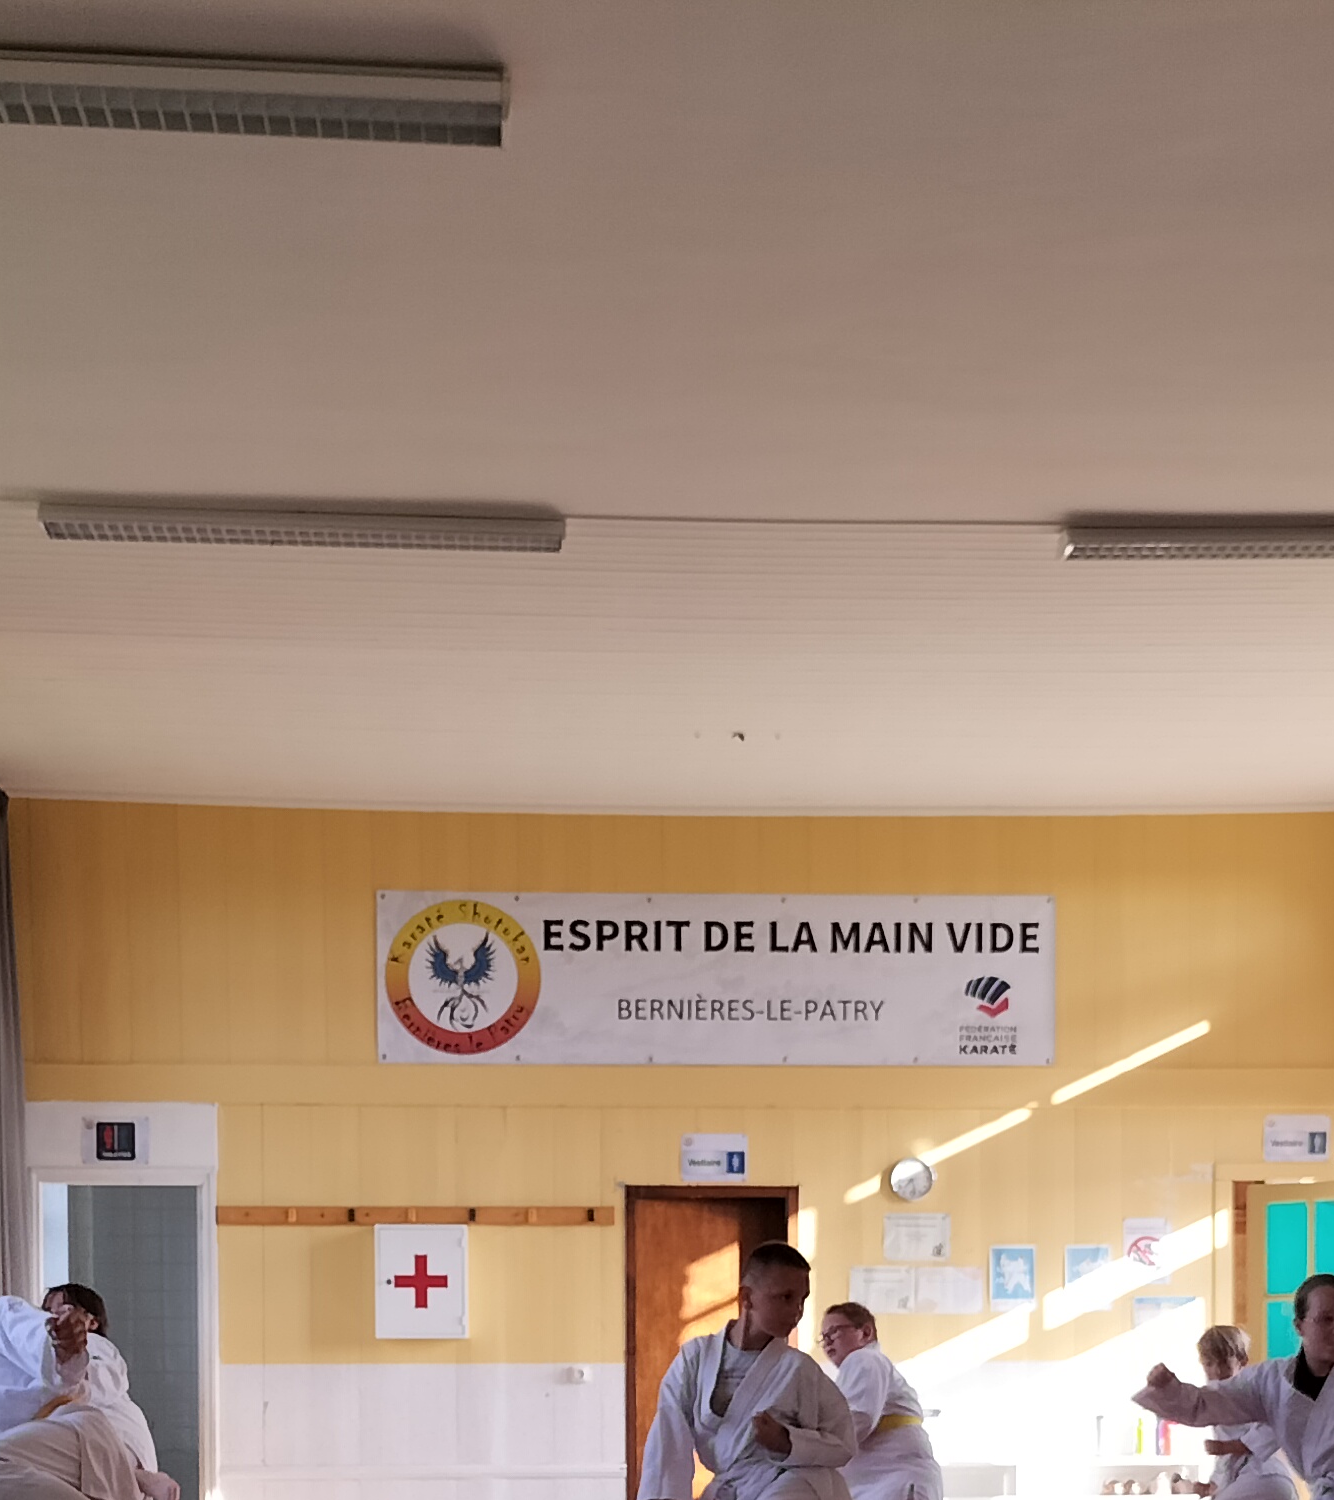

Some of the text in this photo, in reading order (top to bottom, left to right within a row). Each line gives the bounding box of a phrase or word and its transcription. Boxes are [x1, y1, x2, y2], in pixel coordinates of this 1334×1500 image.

[543, 919, 1040, 954] ESPRIT DE LA MAIN VIDE
[617, 993, 885, 1022] BERNIÈRES-LE-PATRY
[959, 1043, 1017, 1055] KARATÉ
